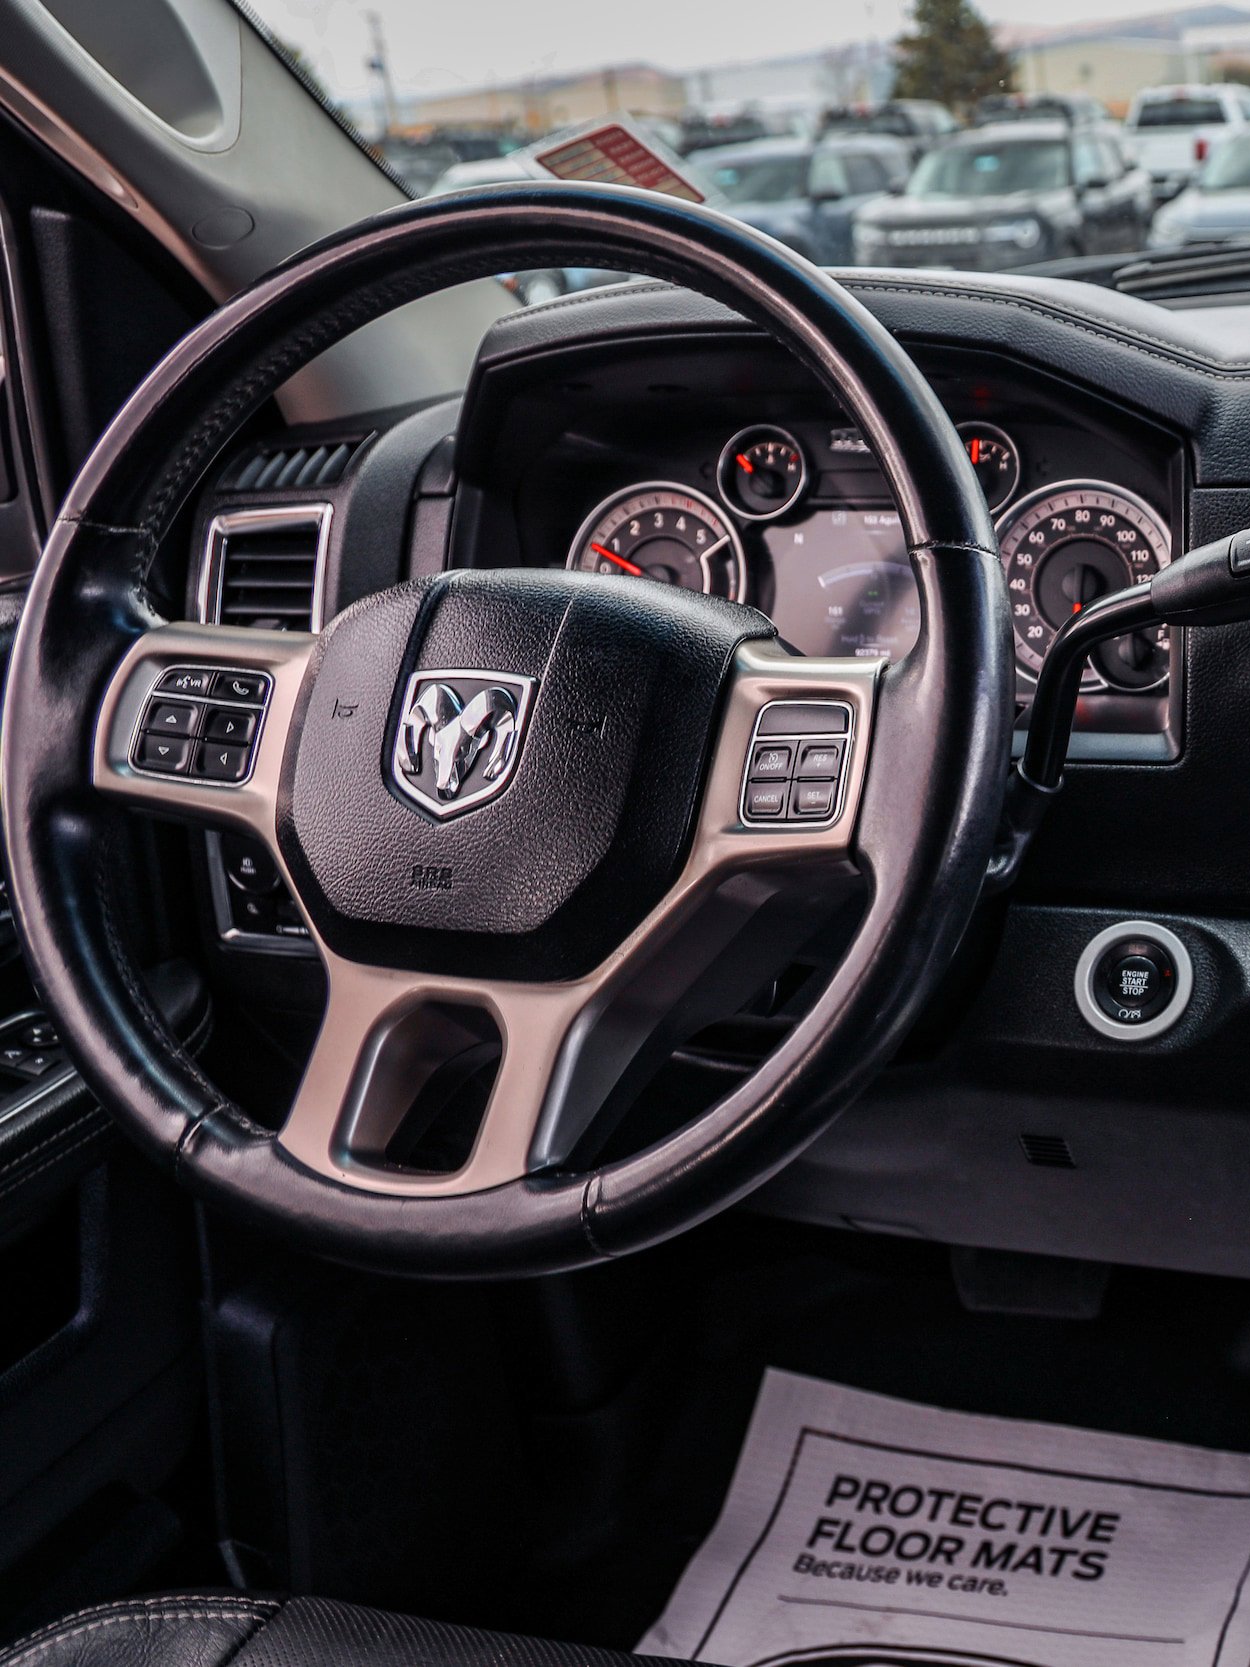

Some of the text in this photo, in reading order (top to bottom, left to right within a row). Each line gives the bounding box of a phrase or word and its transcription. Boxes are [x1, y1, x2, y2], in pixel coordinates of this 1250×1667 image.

[654, 512, 664, 528] 3
[1075, 510, 1090, 522] 80
[1100, 514, 1116, 527] 90
[630, 520, 641, 536] 2
[676, 516, 686, 531] 4
[1050, 518, 1066, 530] 70
[696, 528, 706, 544] 5
[1028, 532, 1045, 544] 60
[1116, 530, 1136, 542] 100
[612, 538, 620, 552] 1
[1016, 554, 1032, 566] 50
[1131, 550, 1150, 562] 110
[1010, 578, 1026, 590] 40
[1014, 604, 1030, 616] 30
[1028, 626, 1044, 638] 20
[190, 678, 202, 688] VR
[813, 754, 828, 762] RES
[754, 795, 778, 804] CANCEL
[1122, 970, 1150, 979] ENGINE
[1122, 978, 1148, 986] START
[1122, 988, 1145, 996] STOP
[824, 1473, 1122, 1544] PROTECTIVE
[804, 1516, 1110, 1582] FLOOR MATS
[792, 1552, 1009, 1597] Because we care.
